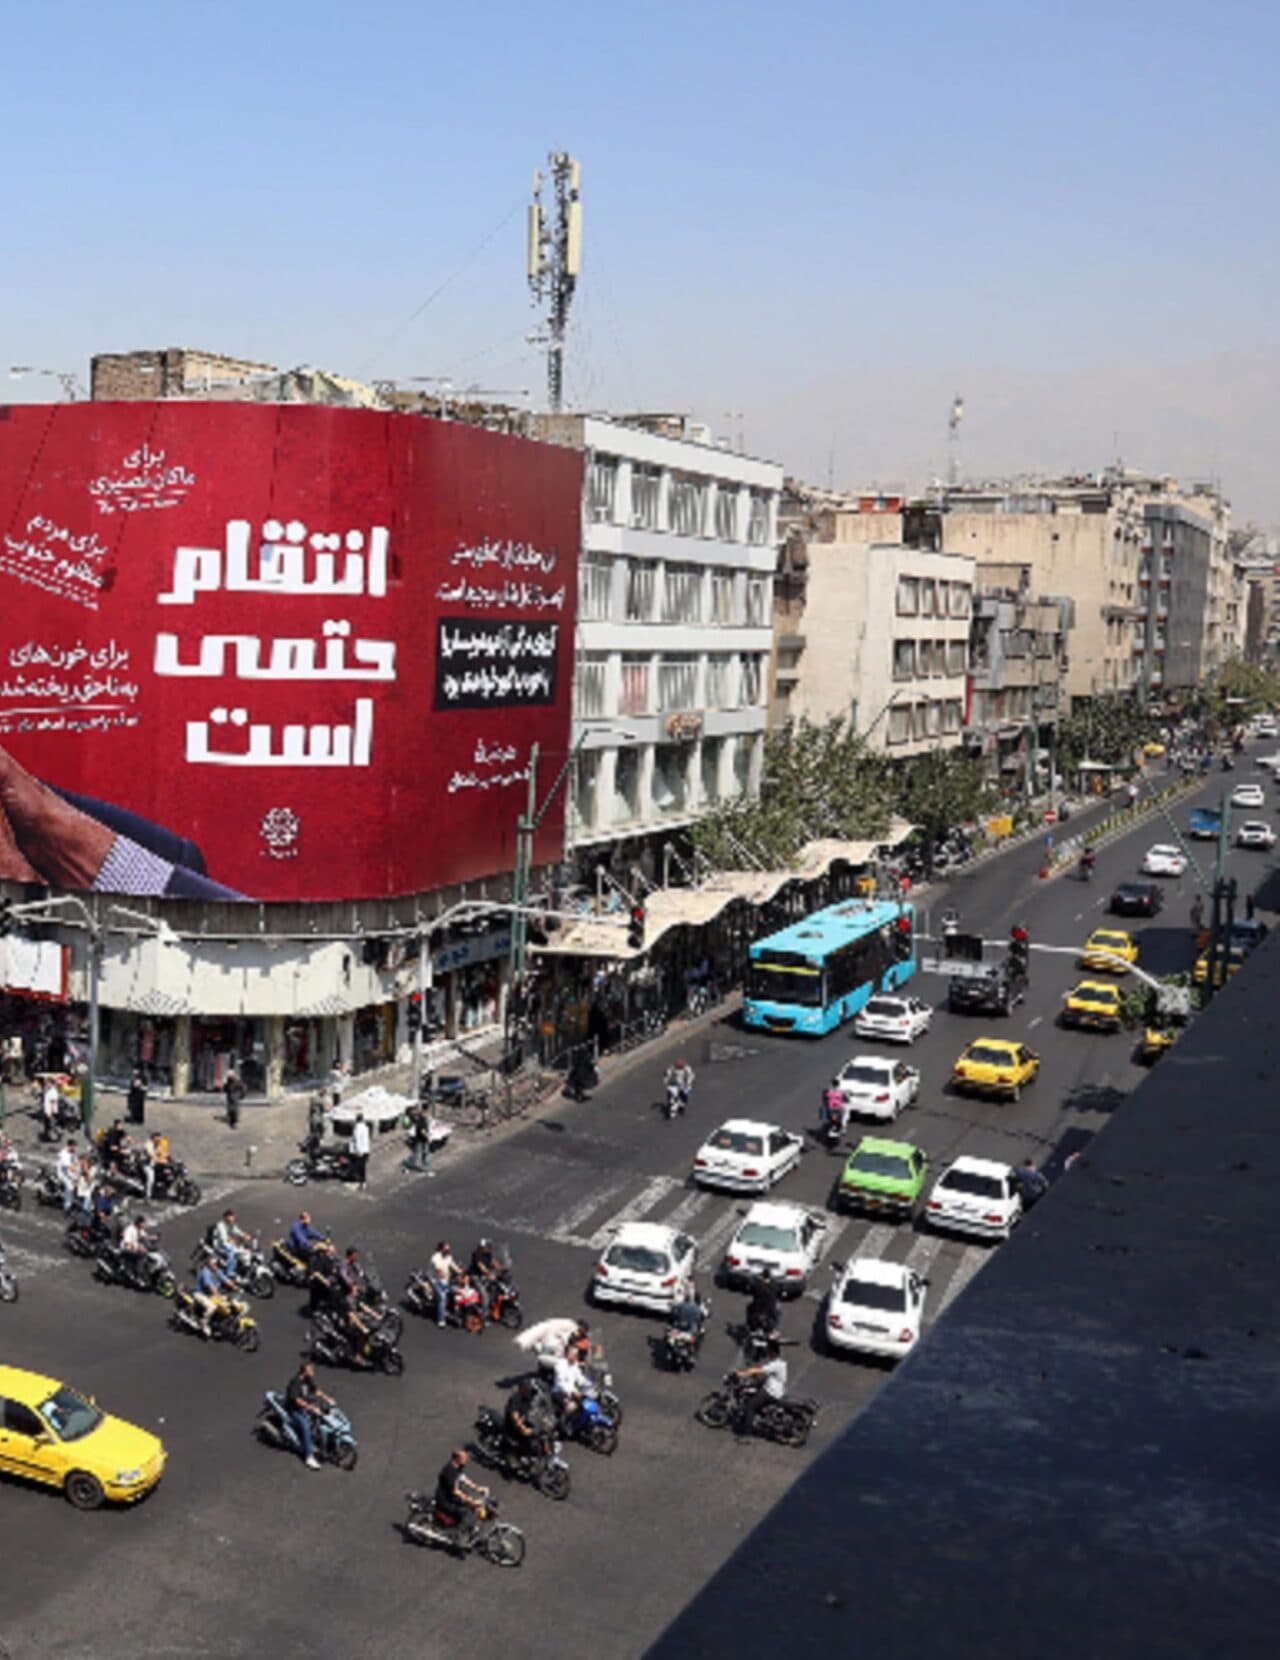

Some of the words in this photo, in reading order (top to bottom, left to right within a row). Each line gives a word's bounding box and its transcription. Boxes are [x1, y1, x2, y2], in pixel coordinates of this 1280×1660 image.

[123, 444, 165, 468] برای
[89, 471, 150, 495] نصیری
[152, 466, 196, 491] ماکان
[27, 515, 69, 541] مردم
[4, 534, 56, 561] جنوب
[69, 534, 108, 563] برای
[54, 560, 104, 588] مظلوم
[158, 520, 389, 604] انتقام
[90, 638, 129, 670] برای
[154, 620, 396, 680] حتمی
[186, 699, 372, 765] است
